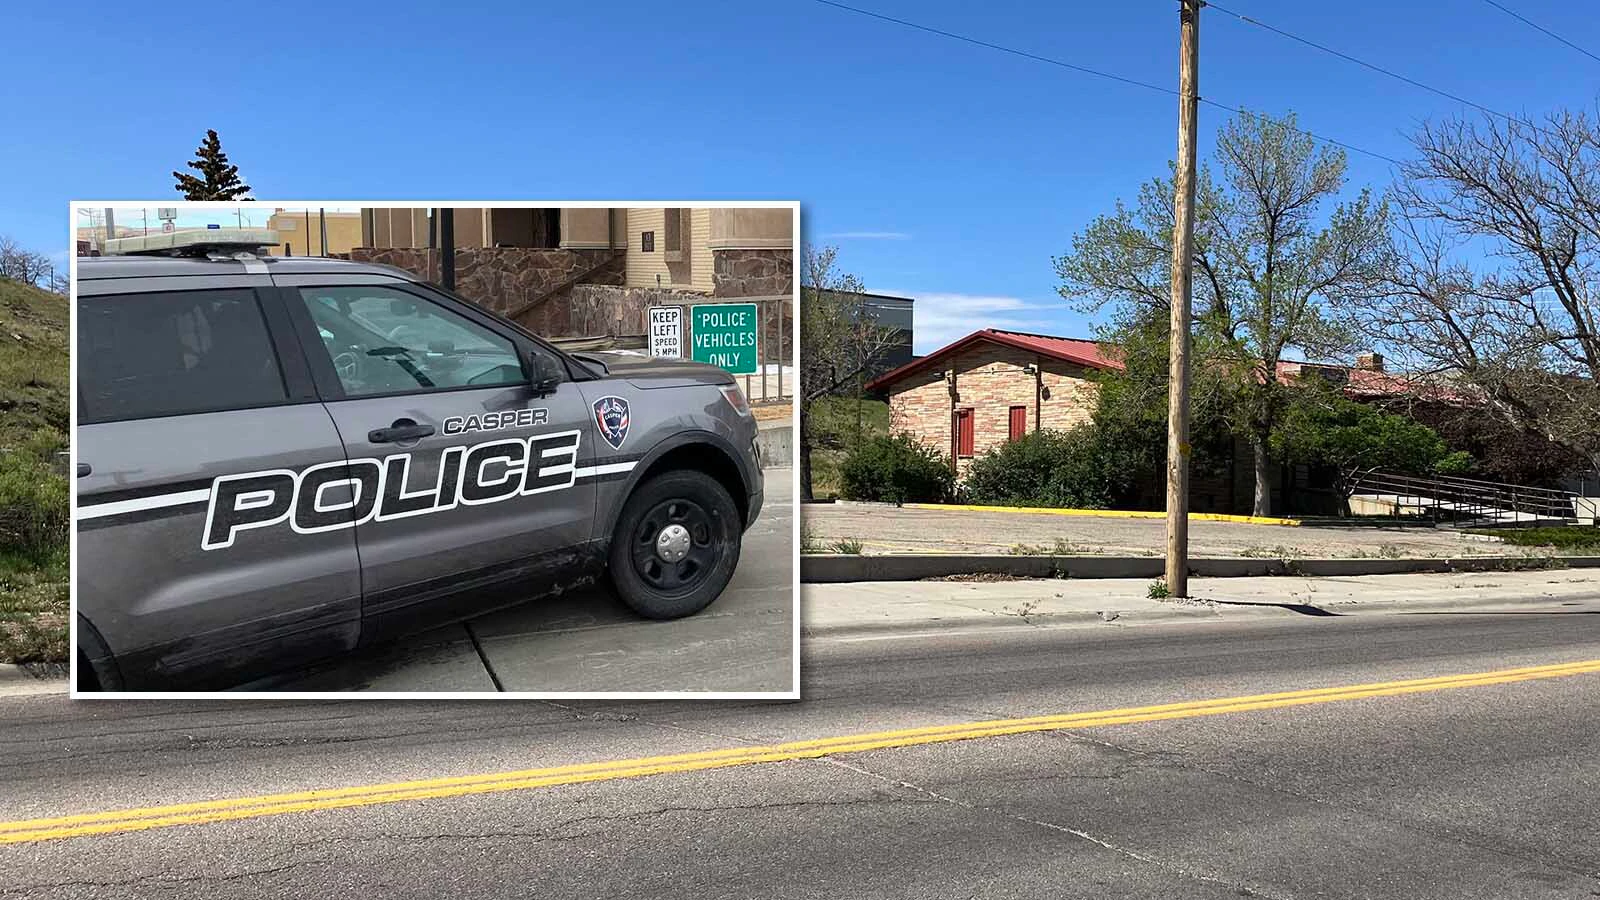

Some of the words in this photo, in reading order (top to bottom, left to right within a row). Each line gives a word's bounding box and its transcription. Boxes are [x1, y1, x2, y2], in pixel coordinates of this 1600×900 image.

[652, 312, 678, 323] KEEP
[702, 312, 747, 328] POLICE
[653, 325, 677, 336] LEFT
[655, 338, 677, 346] SPEED
[695, 332, 754, 348] VEHICLES
[655, 348, 660, 356] 5
[709, 352, 740, 367] ONLY
[442, 408, 549, 436] CASPER
[201, 430, 582, 551] POLICE
